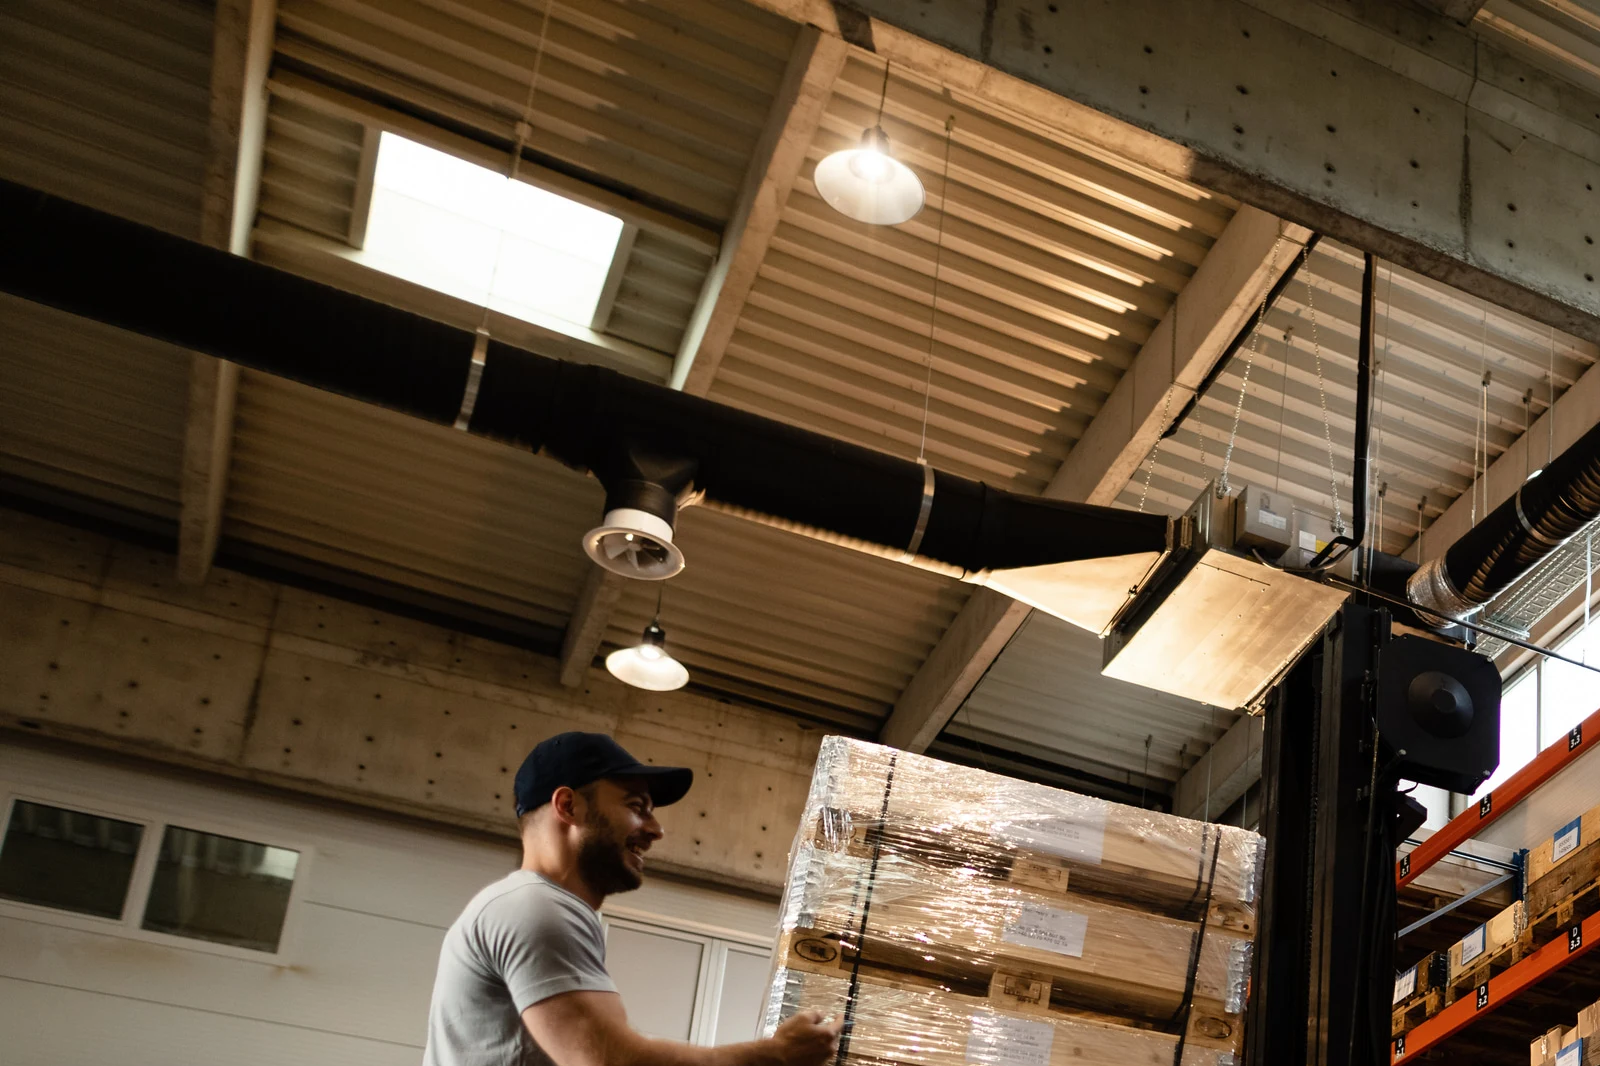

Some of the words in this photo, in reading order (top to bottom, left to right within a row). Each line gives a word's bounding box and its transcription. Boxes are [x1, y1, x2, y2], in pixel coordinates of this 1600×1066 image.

[1573, 927, 1577, 937] D
[1571, 936, 1580, 949] 3.3
[1481, 986, 1487, 996] D
[1478, 994, 1487, 1007] 3.2
[1398, 1038, 1403, 1048] D
